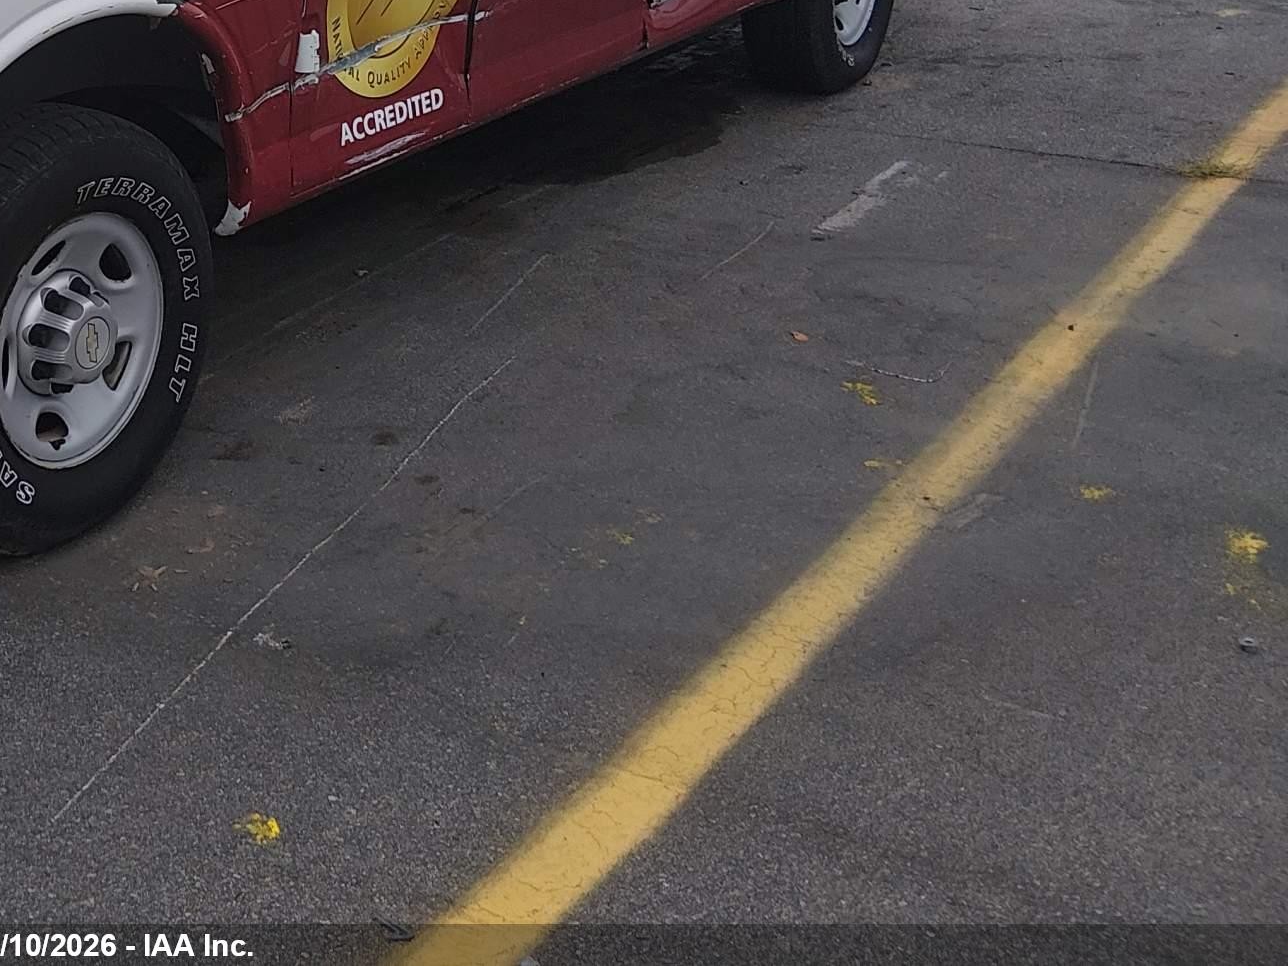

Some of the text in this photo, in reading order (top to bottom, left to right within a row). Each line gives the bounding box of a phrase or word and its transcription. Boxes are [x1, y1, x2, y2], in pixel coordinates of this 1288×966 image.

[367, 56, 412, 89] QUALITY
[340, 88, 444, 146] ACCREDITED
[77, 177, 201, 403] TERRAMAX HLT
